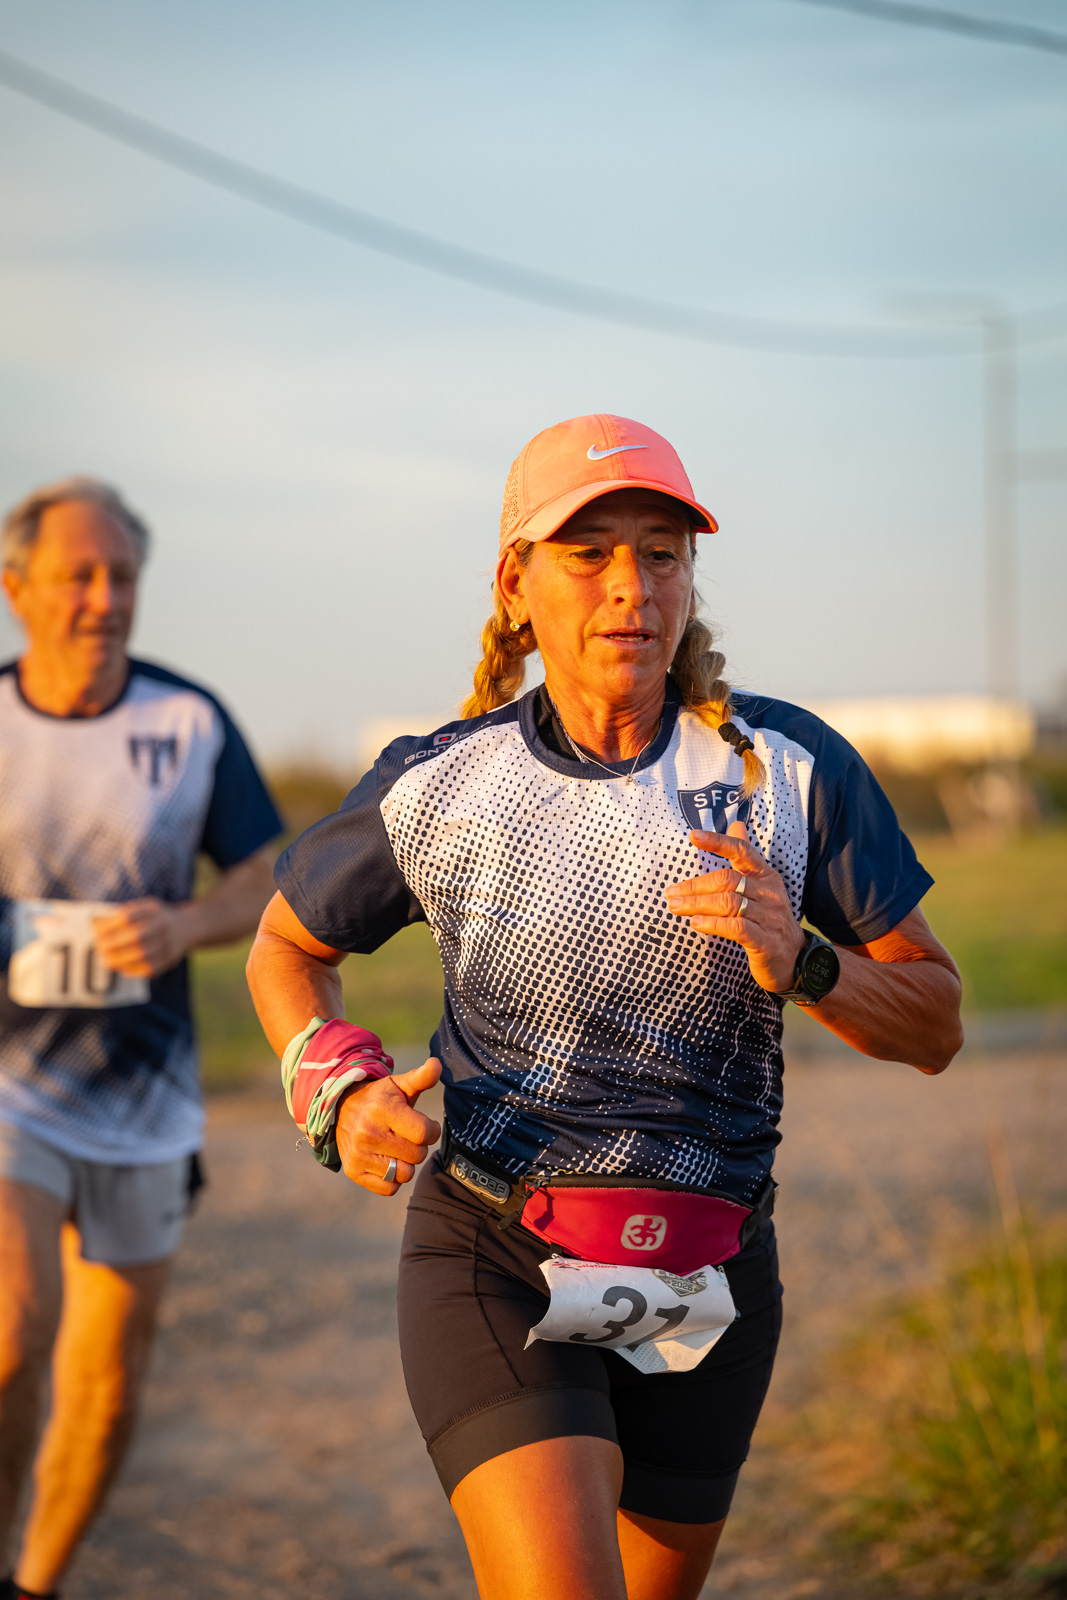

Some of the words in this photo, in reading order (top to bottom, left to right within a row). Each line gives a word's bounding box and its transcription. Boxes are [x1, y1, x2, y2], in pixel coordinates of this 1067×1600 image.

[693, 789, 740, 808] SFC
[671, 1280, 693, 1292] 2026
[568, 1285, 690, 1353] 31
